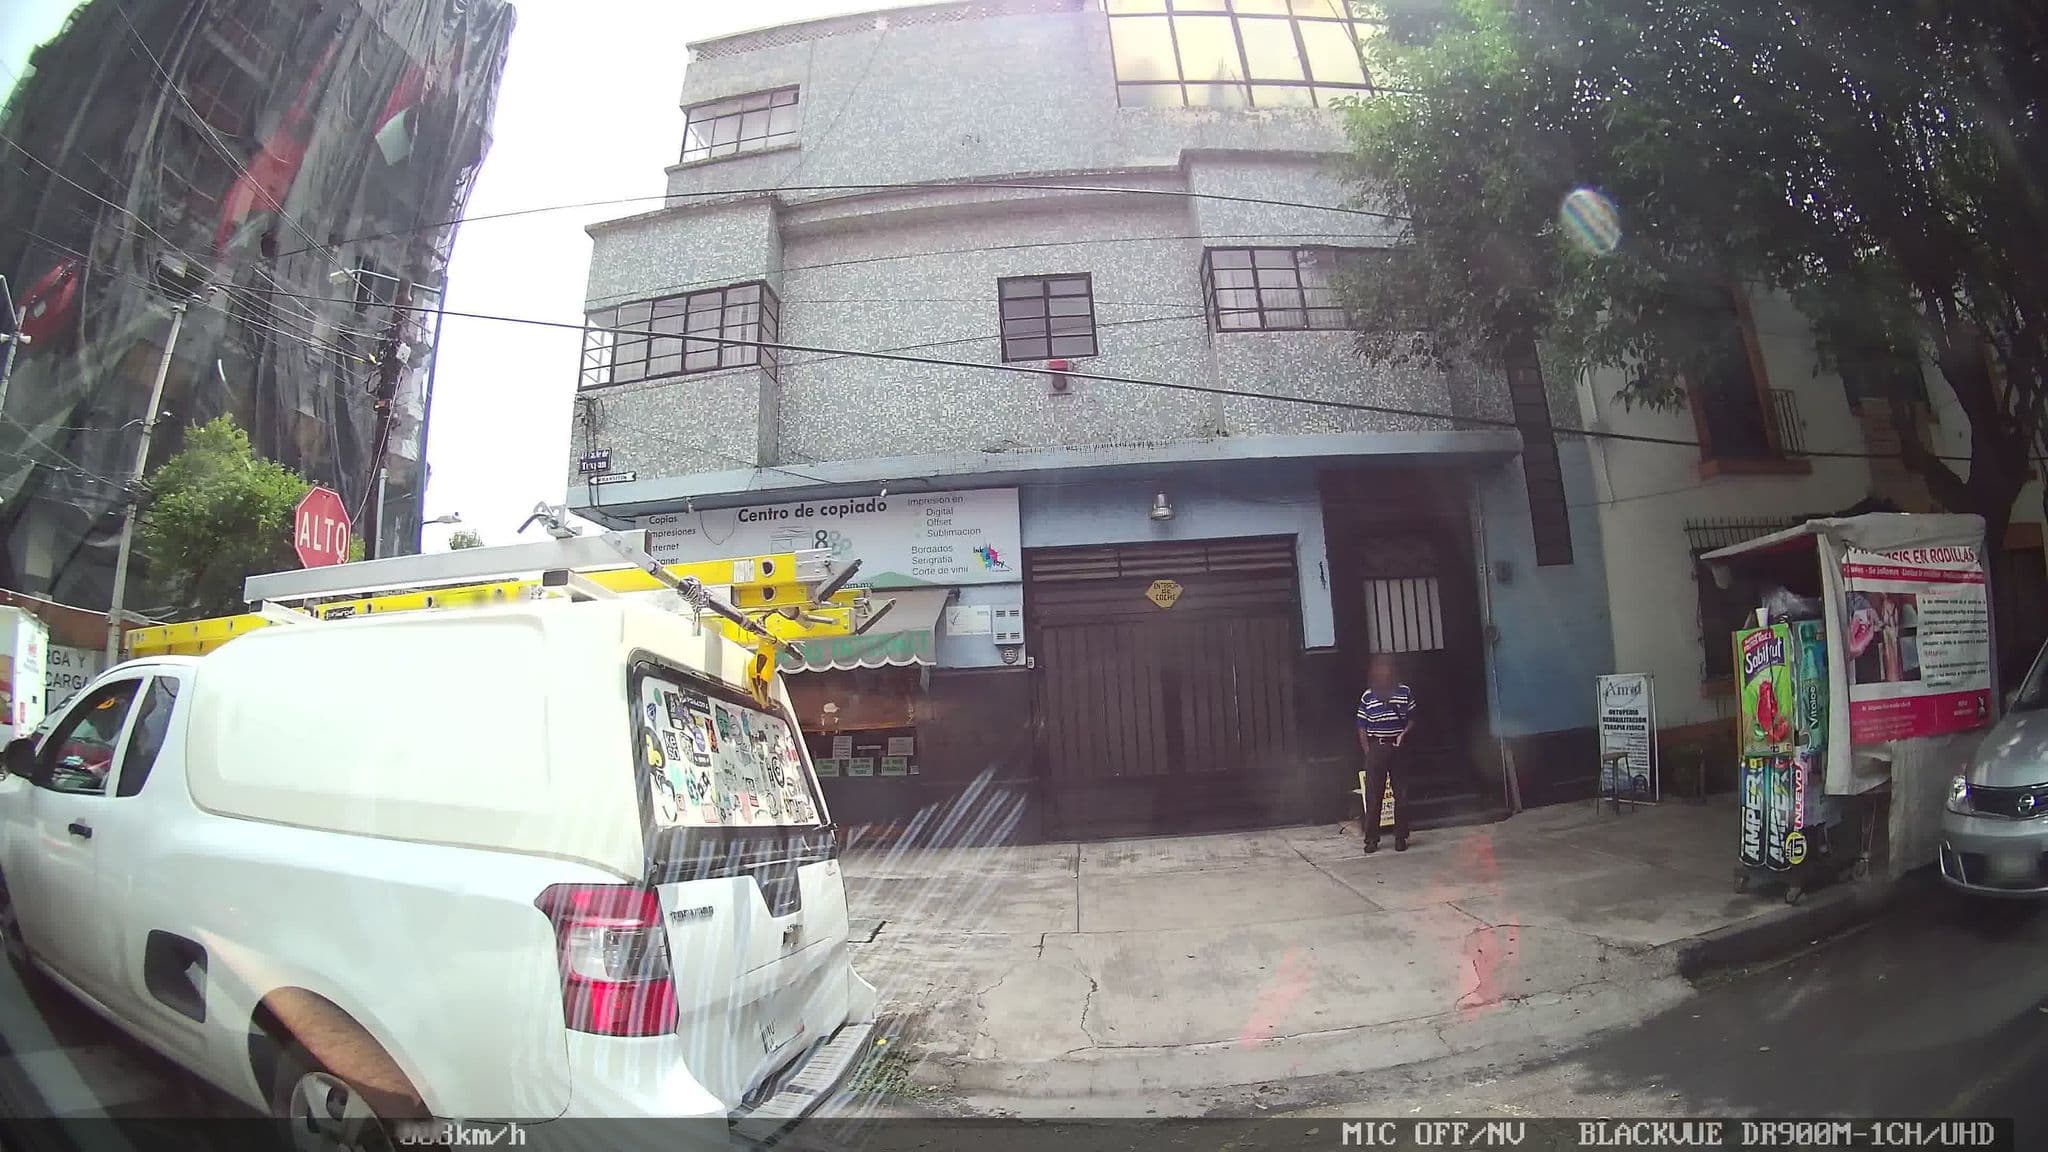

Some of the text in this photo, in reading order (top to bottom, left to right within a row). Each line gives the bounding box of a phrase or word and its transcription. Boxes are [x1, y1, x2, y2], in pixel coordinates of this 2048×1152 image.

[738, 498, 887, 522] Centro de copiado
[926, 507, 954, 517] Digital
[648, 515, 677, 525] Copias
[926, 518, 952, 527] Offset
[299, 512, 347, 556] ALTO
[651, 527, 697, 538] mpresiones
[911, 544, 954, 555] Bordados
[1913, 549, 1929, 564] EN
[1930, 547, 1975, 564] RODILLAS
[912, 567, 936, 576] Corte
[937, 566, 949, 575] de
[77, 656, 86, 668] Y
[1795, 769, 1803, 824] NUEVO
